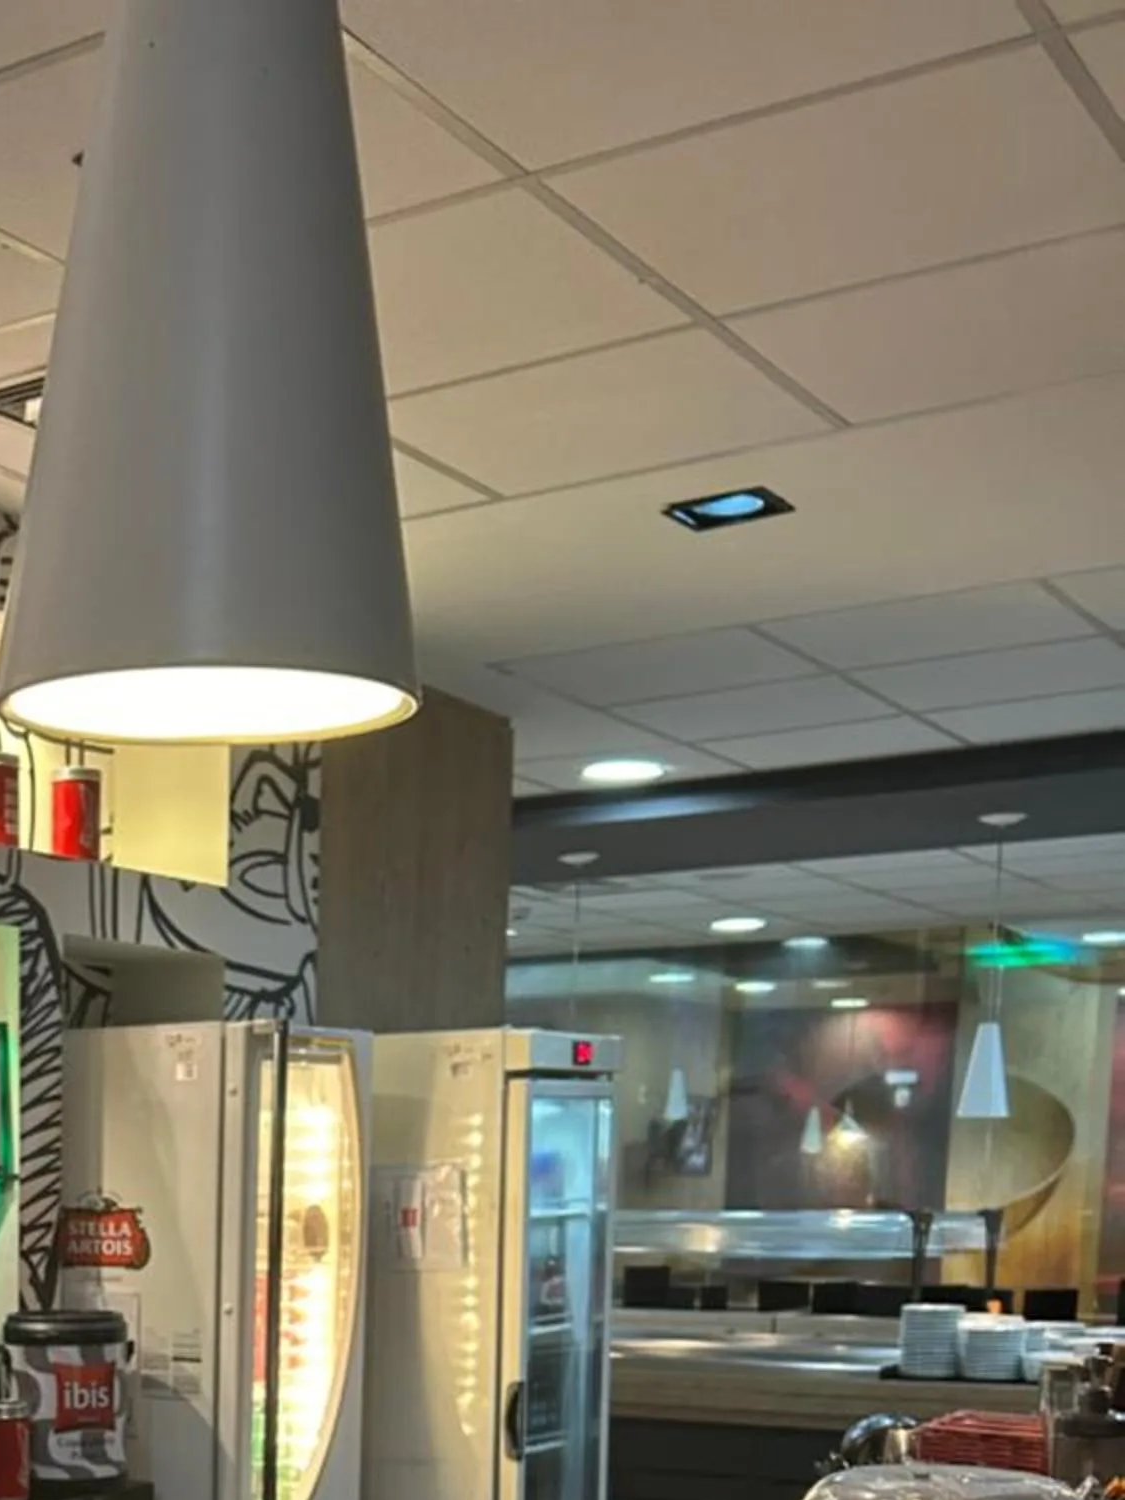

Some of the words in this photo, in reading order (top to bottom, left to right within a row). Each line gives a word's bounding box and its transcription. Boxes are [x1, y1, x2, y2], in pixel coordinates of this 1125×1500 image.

[68, 1221, 132, 1238] STELLA
[67, 1239, 133, 1256] ARTOIS
[63, 1381, 110, 1409] ibis
